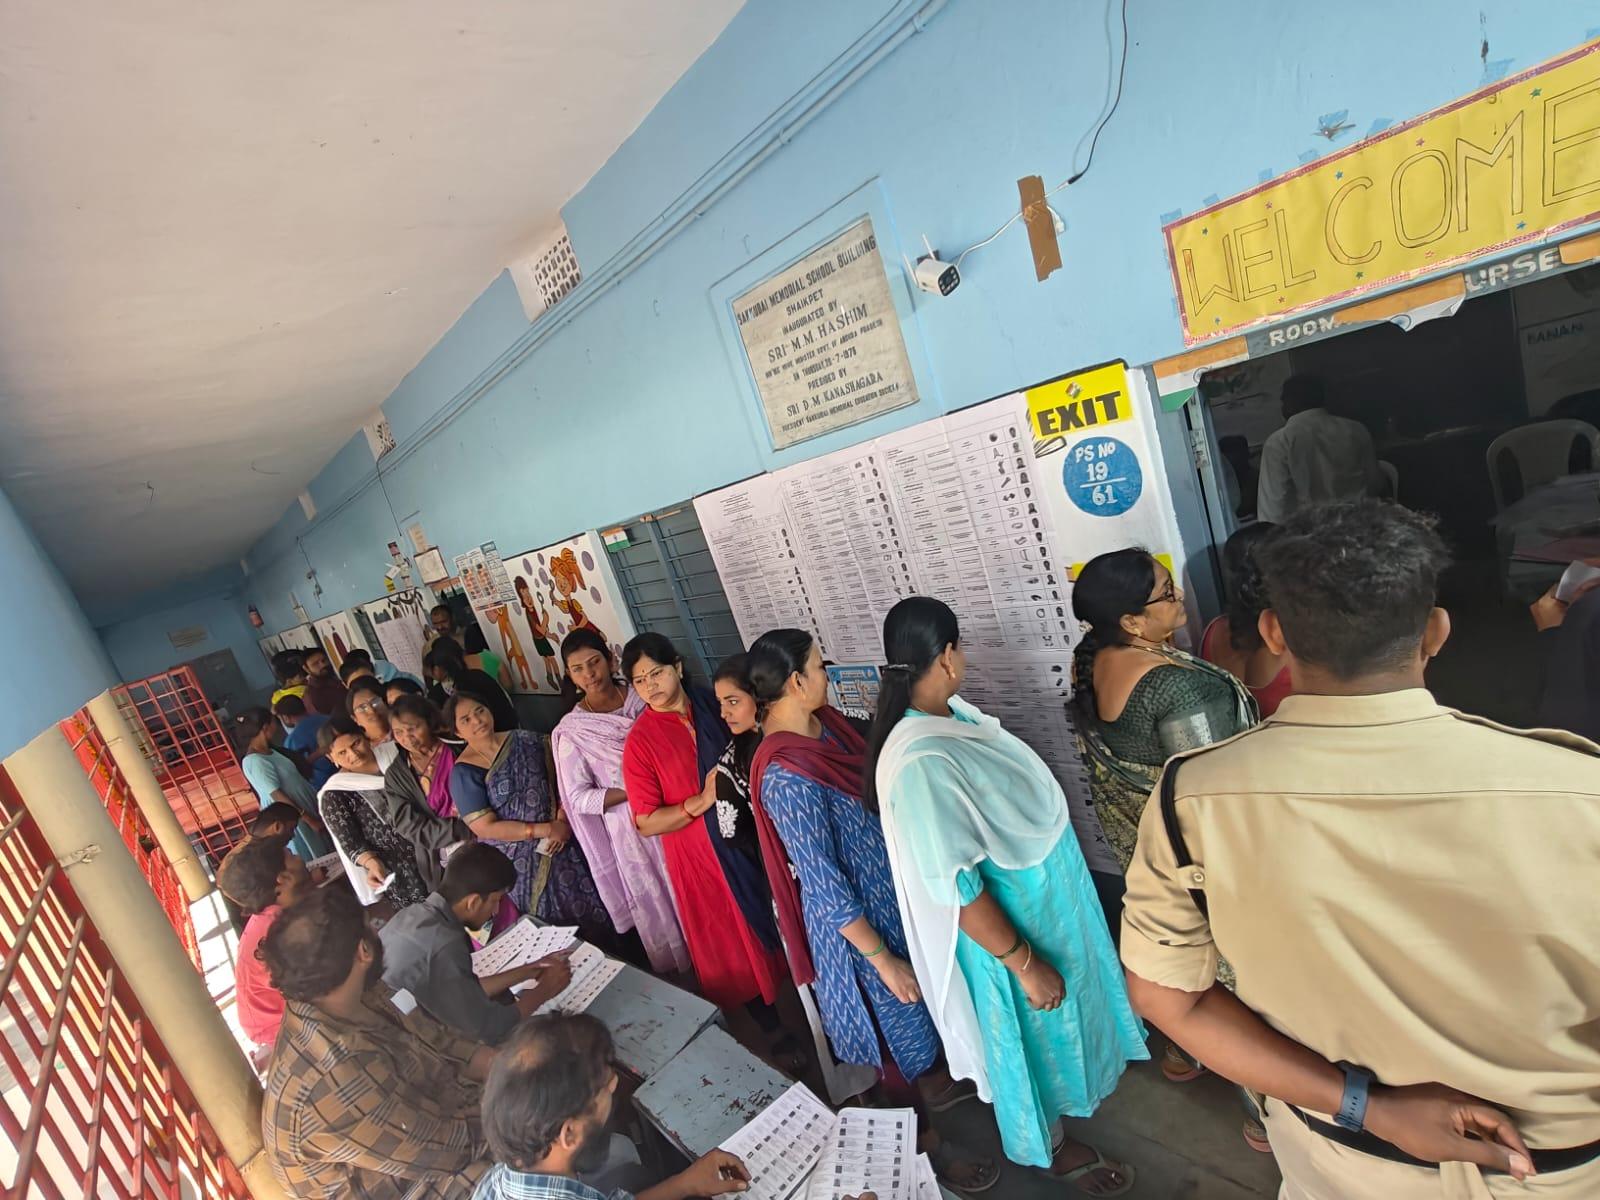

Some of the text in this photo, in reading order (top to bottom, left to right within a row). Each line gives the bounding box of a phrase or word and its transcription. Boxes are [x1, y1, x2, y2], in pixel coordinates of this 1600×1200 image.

[1182, 77, 1600, 317] WELCOME
[768, 277, 806, 307] MEMORIAL
[805, 260, 836, 286] SCHOOL
[836, 234, 876, 268] BUILDING
[786, 288, 823, 316] SHAIKPET
[782, 298, 838, 336] INAUGURATED BY
[817, 303, 868, 339] HASHIM
[807, 367, 847, 391] PRESIDED BY
[786, 402, 800, 417] SRI
[1036, 391, 1121, 436] EXIT
[1075, 445, 1094, 463] PS
[1087, 461, 1109, 482] 19
[1092, 485, 1118, 507] 61
